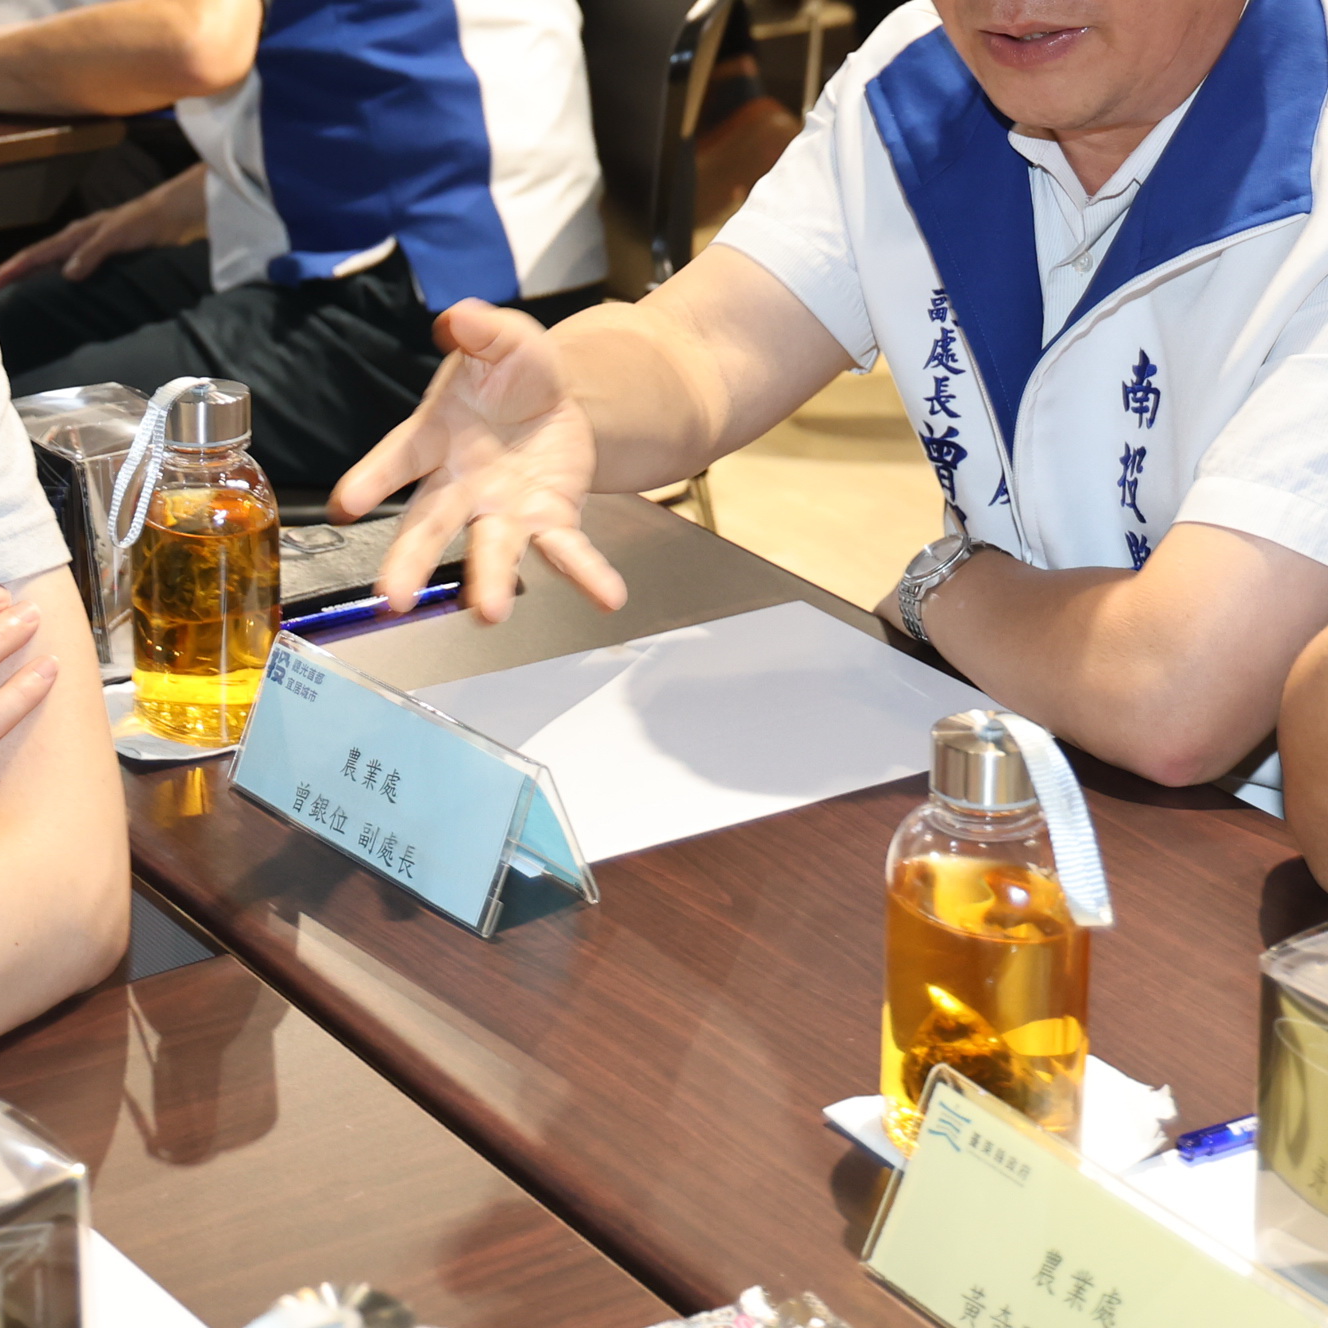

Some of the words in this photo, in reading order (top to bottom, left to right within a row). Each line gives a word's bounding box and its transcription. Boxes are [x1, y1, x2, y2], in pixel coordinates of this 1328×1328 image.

[339, 746, 401, 804] 農業處
[292, 781, 349, 835] 曾銀位
[357, 821, 417, 879] 副處長
[1032, 1248, 1123, 1328] 農業處
